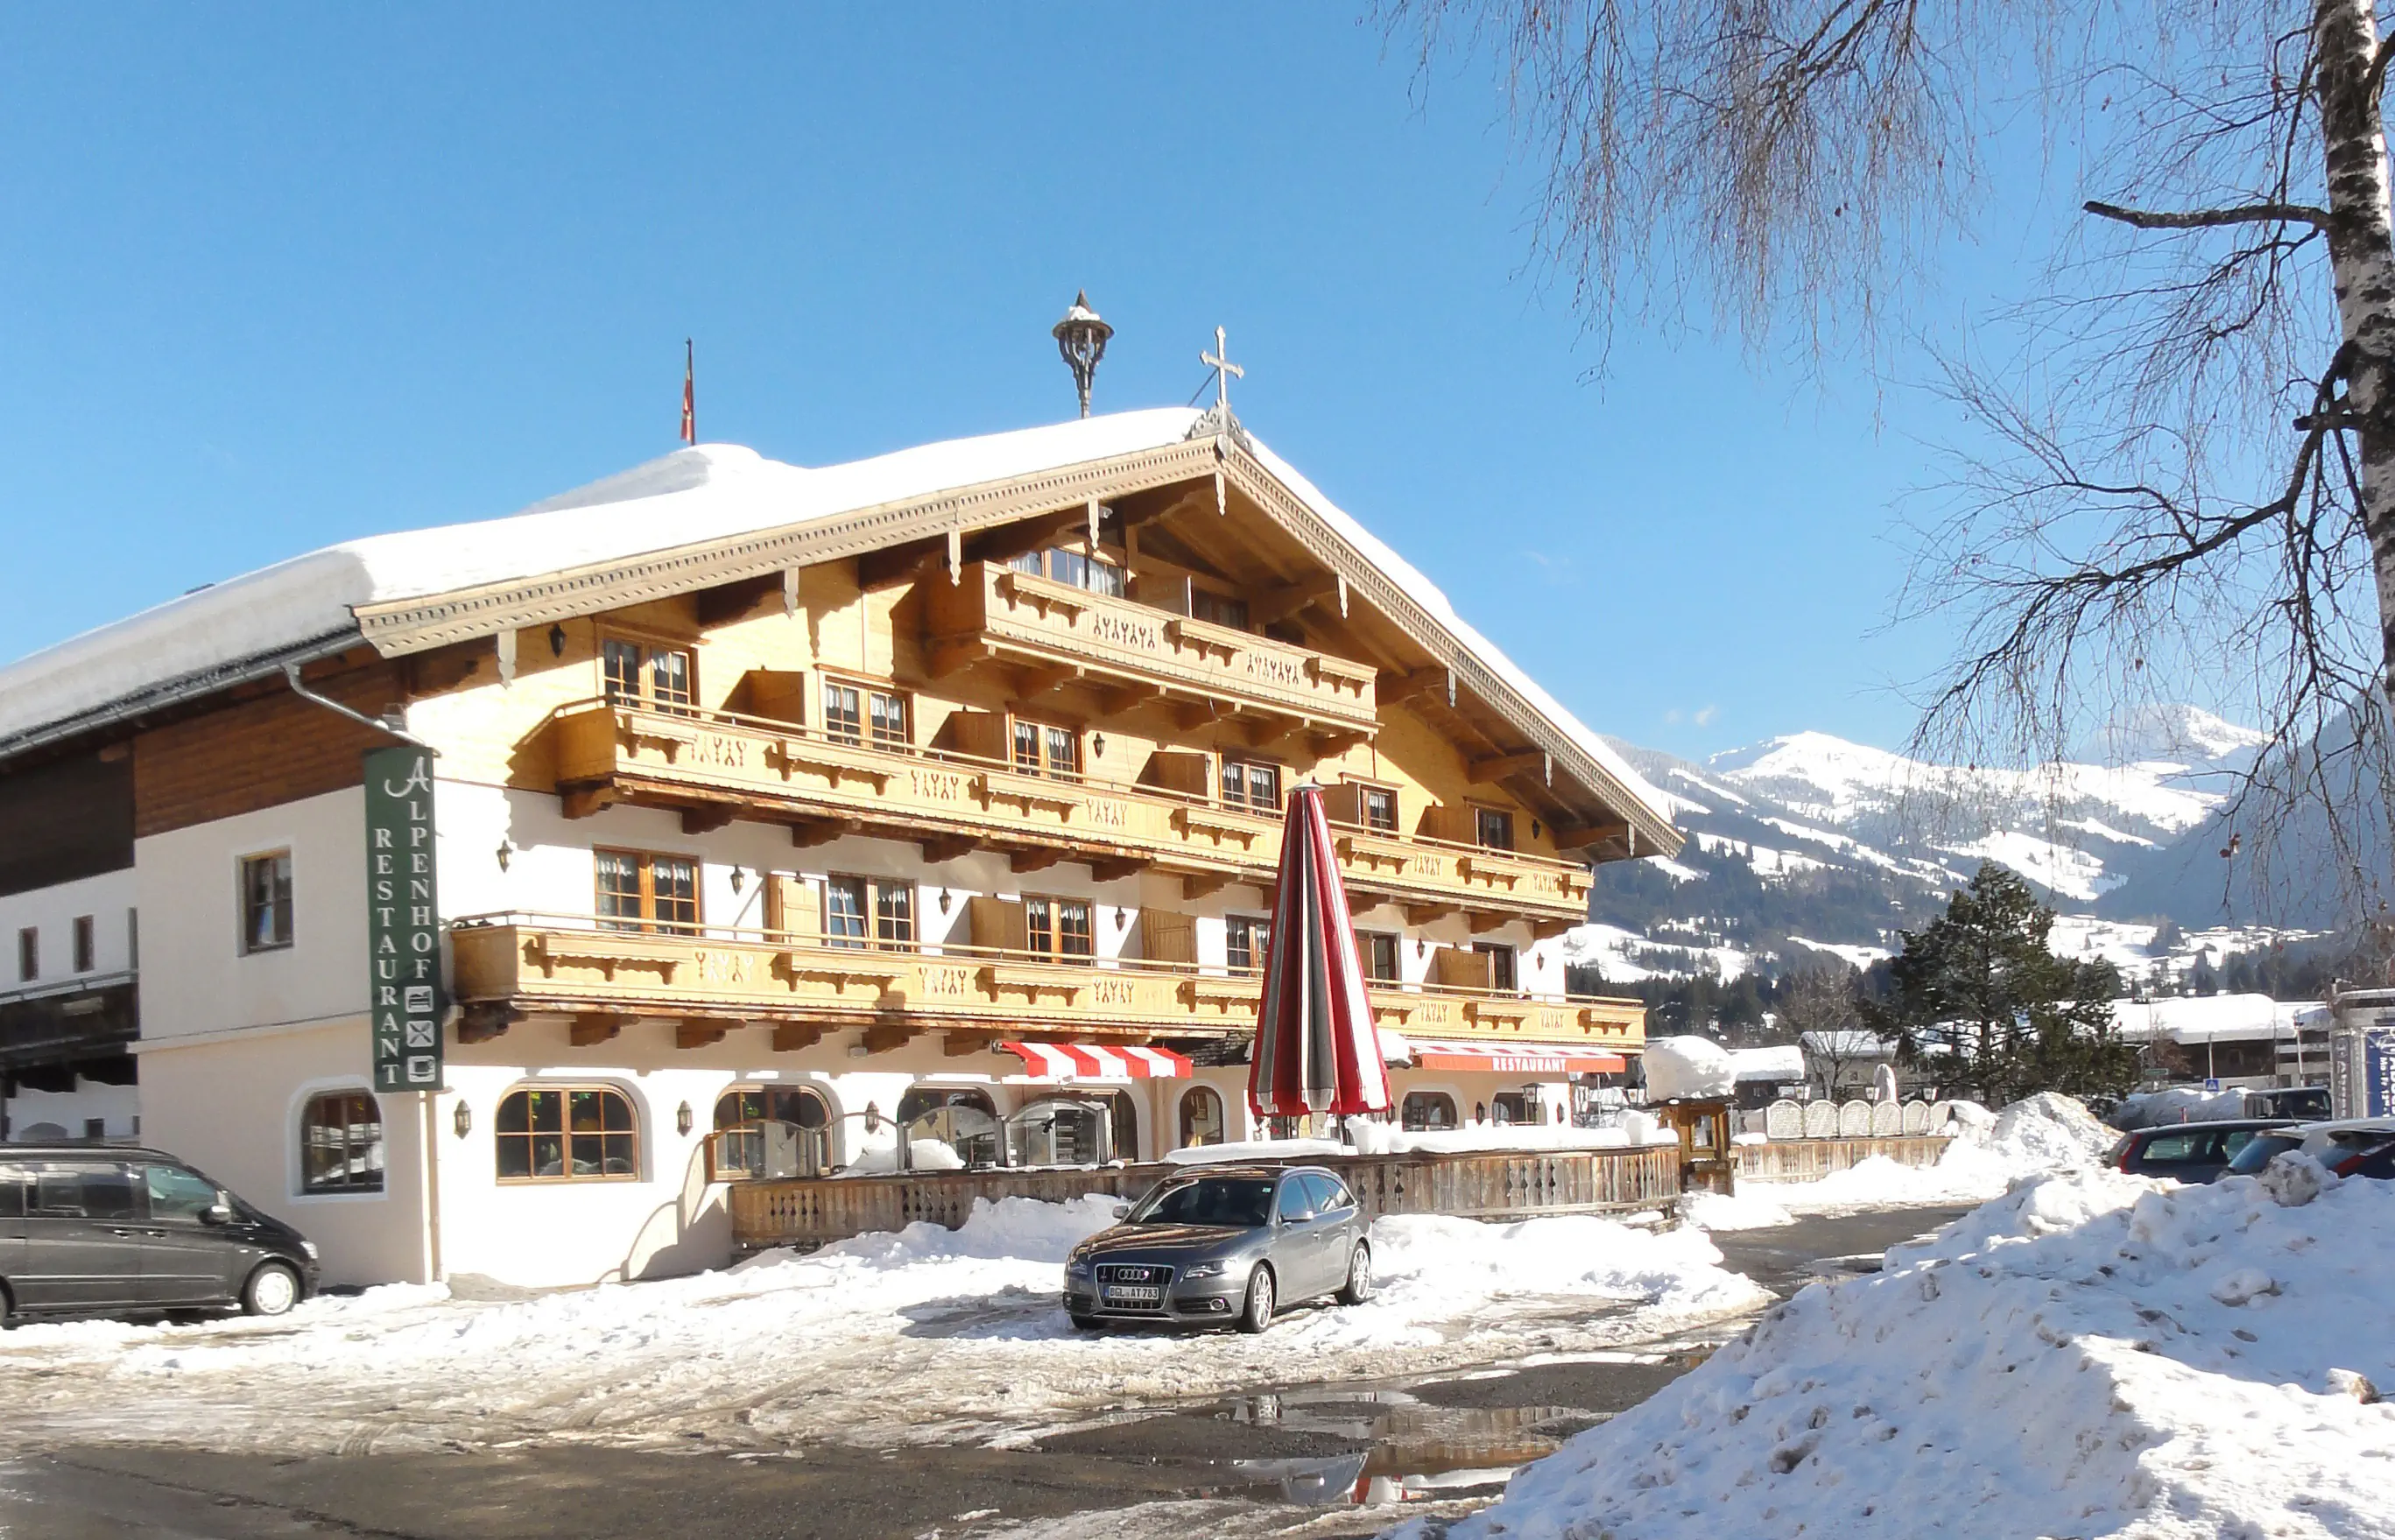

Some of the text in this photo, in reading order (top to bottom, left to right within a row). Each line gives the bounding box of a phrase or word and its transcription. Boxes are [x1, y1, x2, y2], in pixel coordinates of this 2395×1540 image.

[374, 828, 400, 1084] RESTAURANT
[384, 756, 433, 978] ALPENHOF
[1493, 1057, 1566, 1072] RESTAURANT
